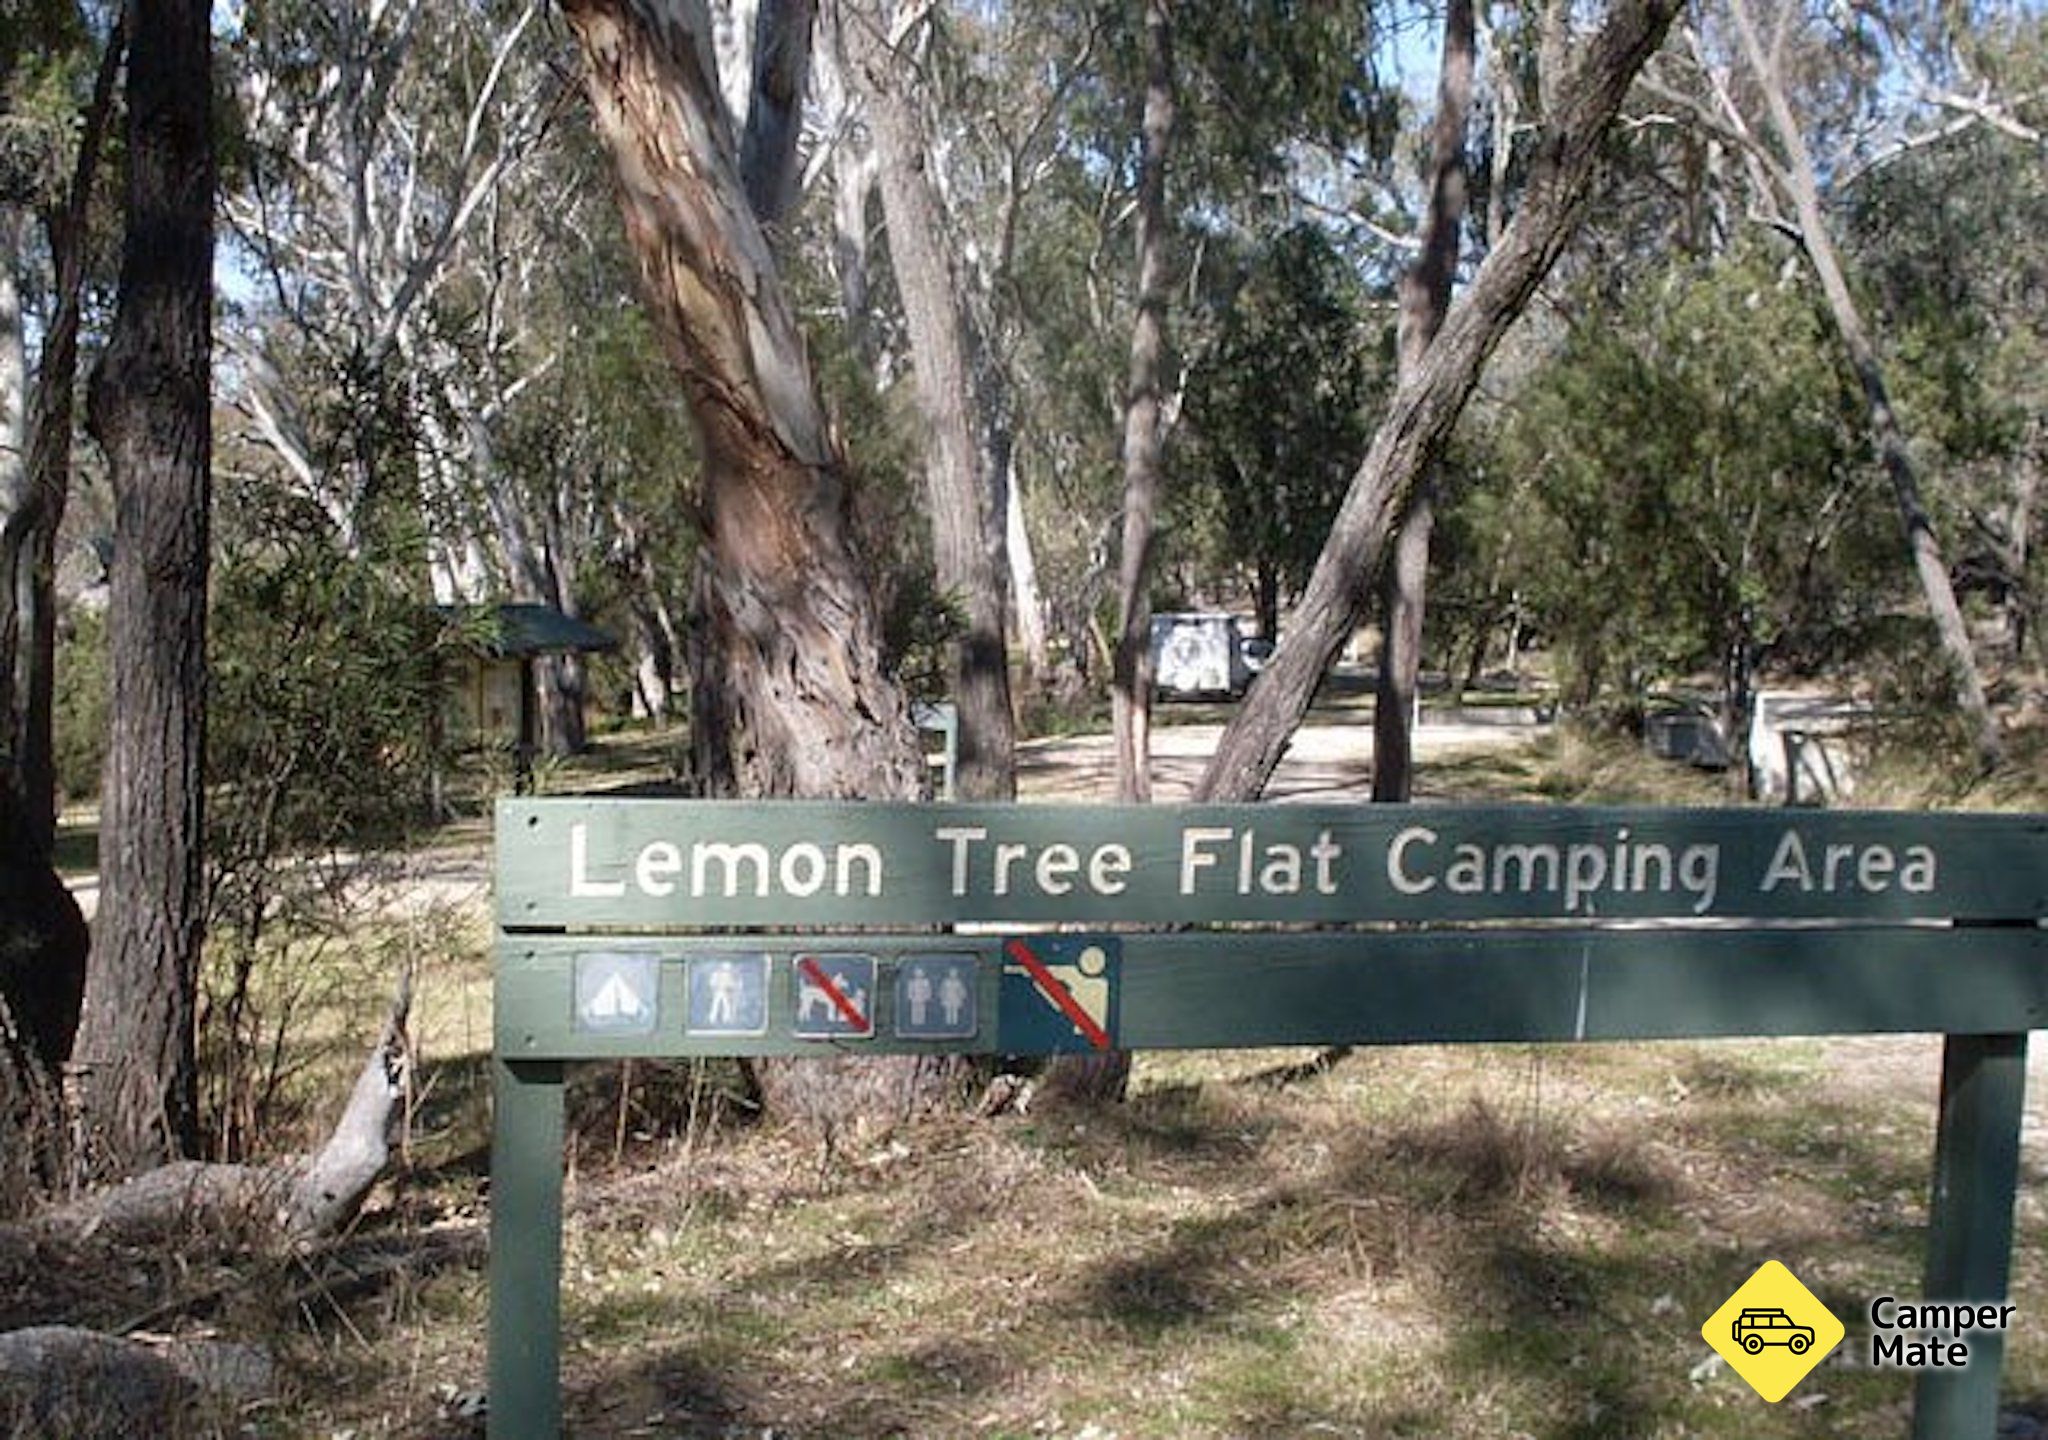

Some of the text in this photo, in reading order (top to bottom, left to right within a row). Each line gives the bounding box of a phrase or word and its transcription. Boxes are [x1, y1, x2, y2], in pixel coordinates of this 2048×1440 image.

[569, 824, 1938, 913] Lemon Tree Flat Camping Area
